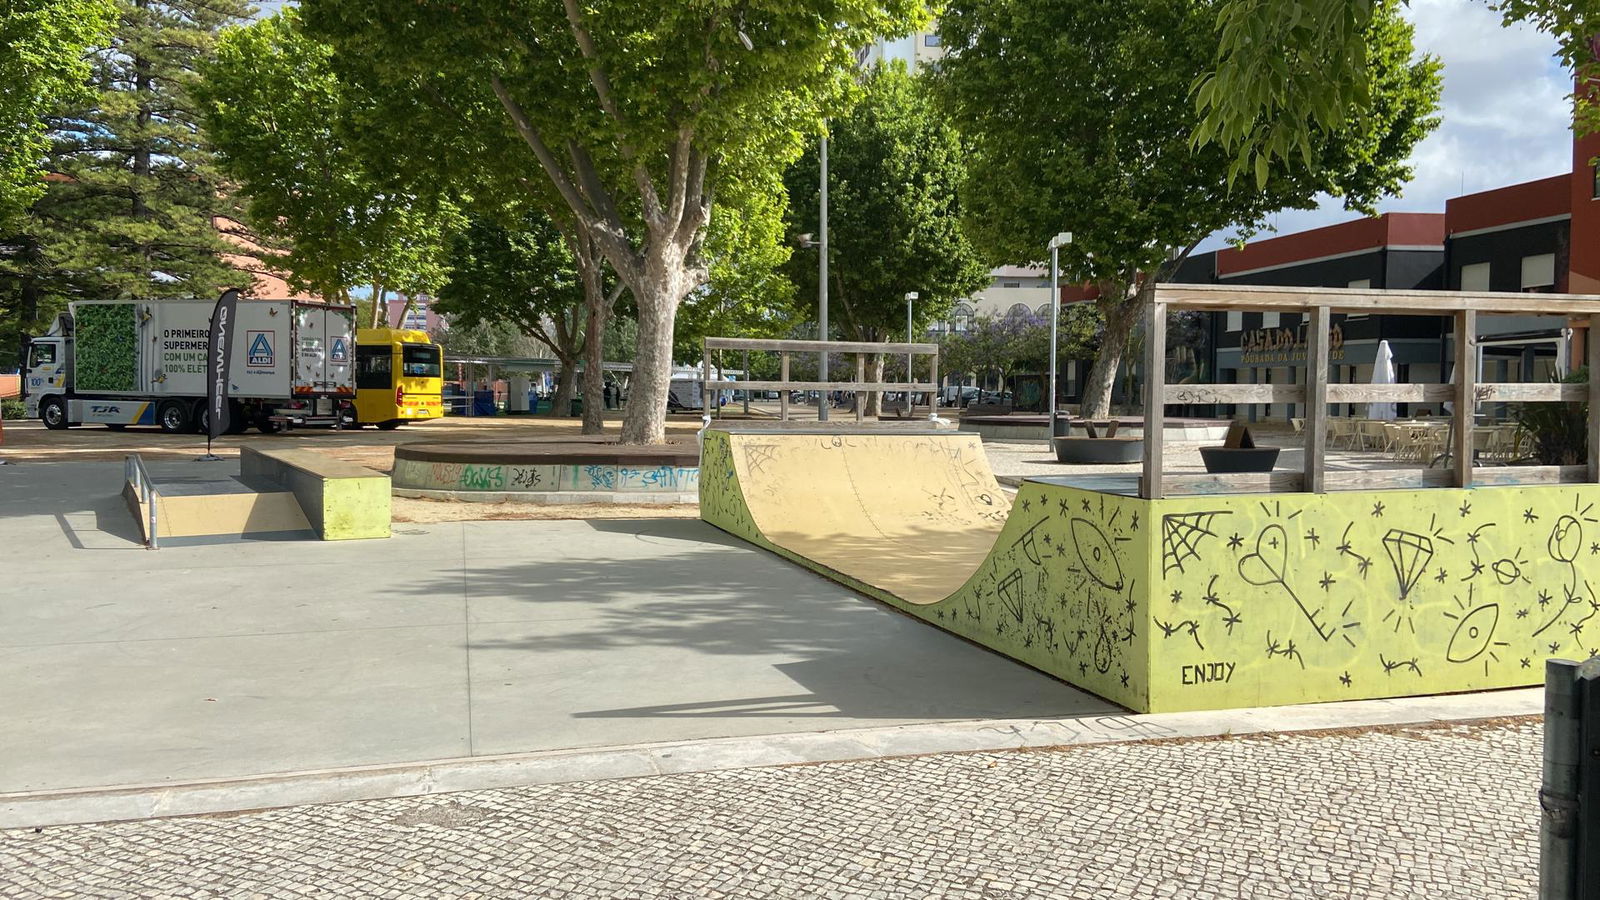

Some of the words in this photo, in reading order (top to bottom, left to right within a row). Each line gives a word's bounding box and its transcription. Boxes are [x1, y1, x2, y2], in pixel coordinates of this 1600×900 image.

[164, 329, 169, 338] O
[171, 329, 210, 338] PRIMEIRO
[164, 341, 208, 350] SUPERMER
[164, 353, 181, 361] COM
[183, 353, 195, 361] UM
[165, 364, 185, 373] 100%
[1182, 662, 1236, 685] ENJOY
